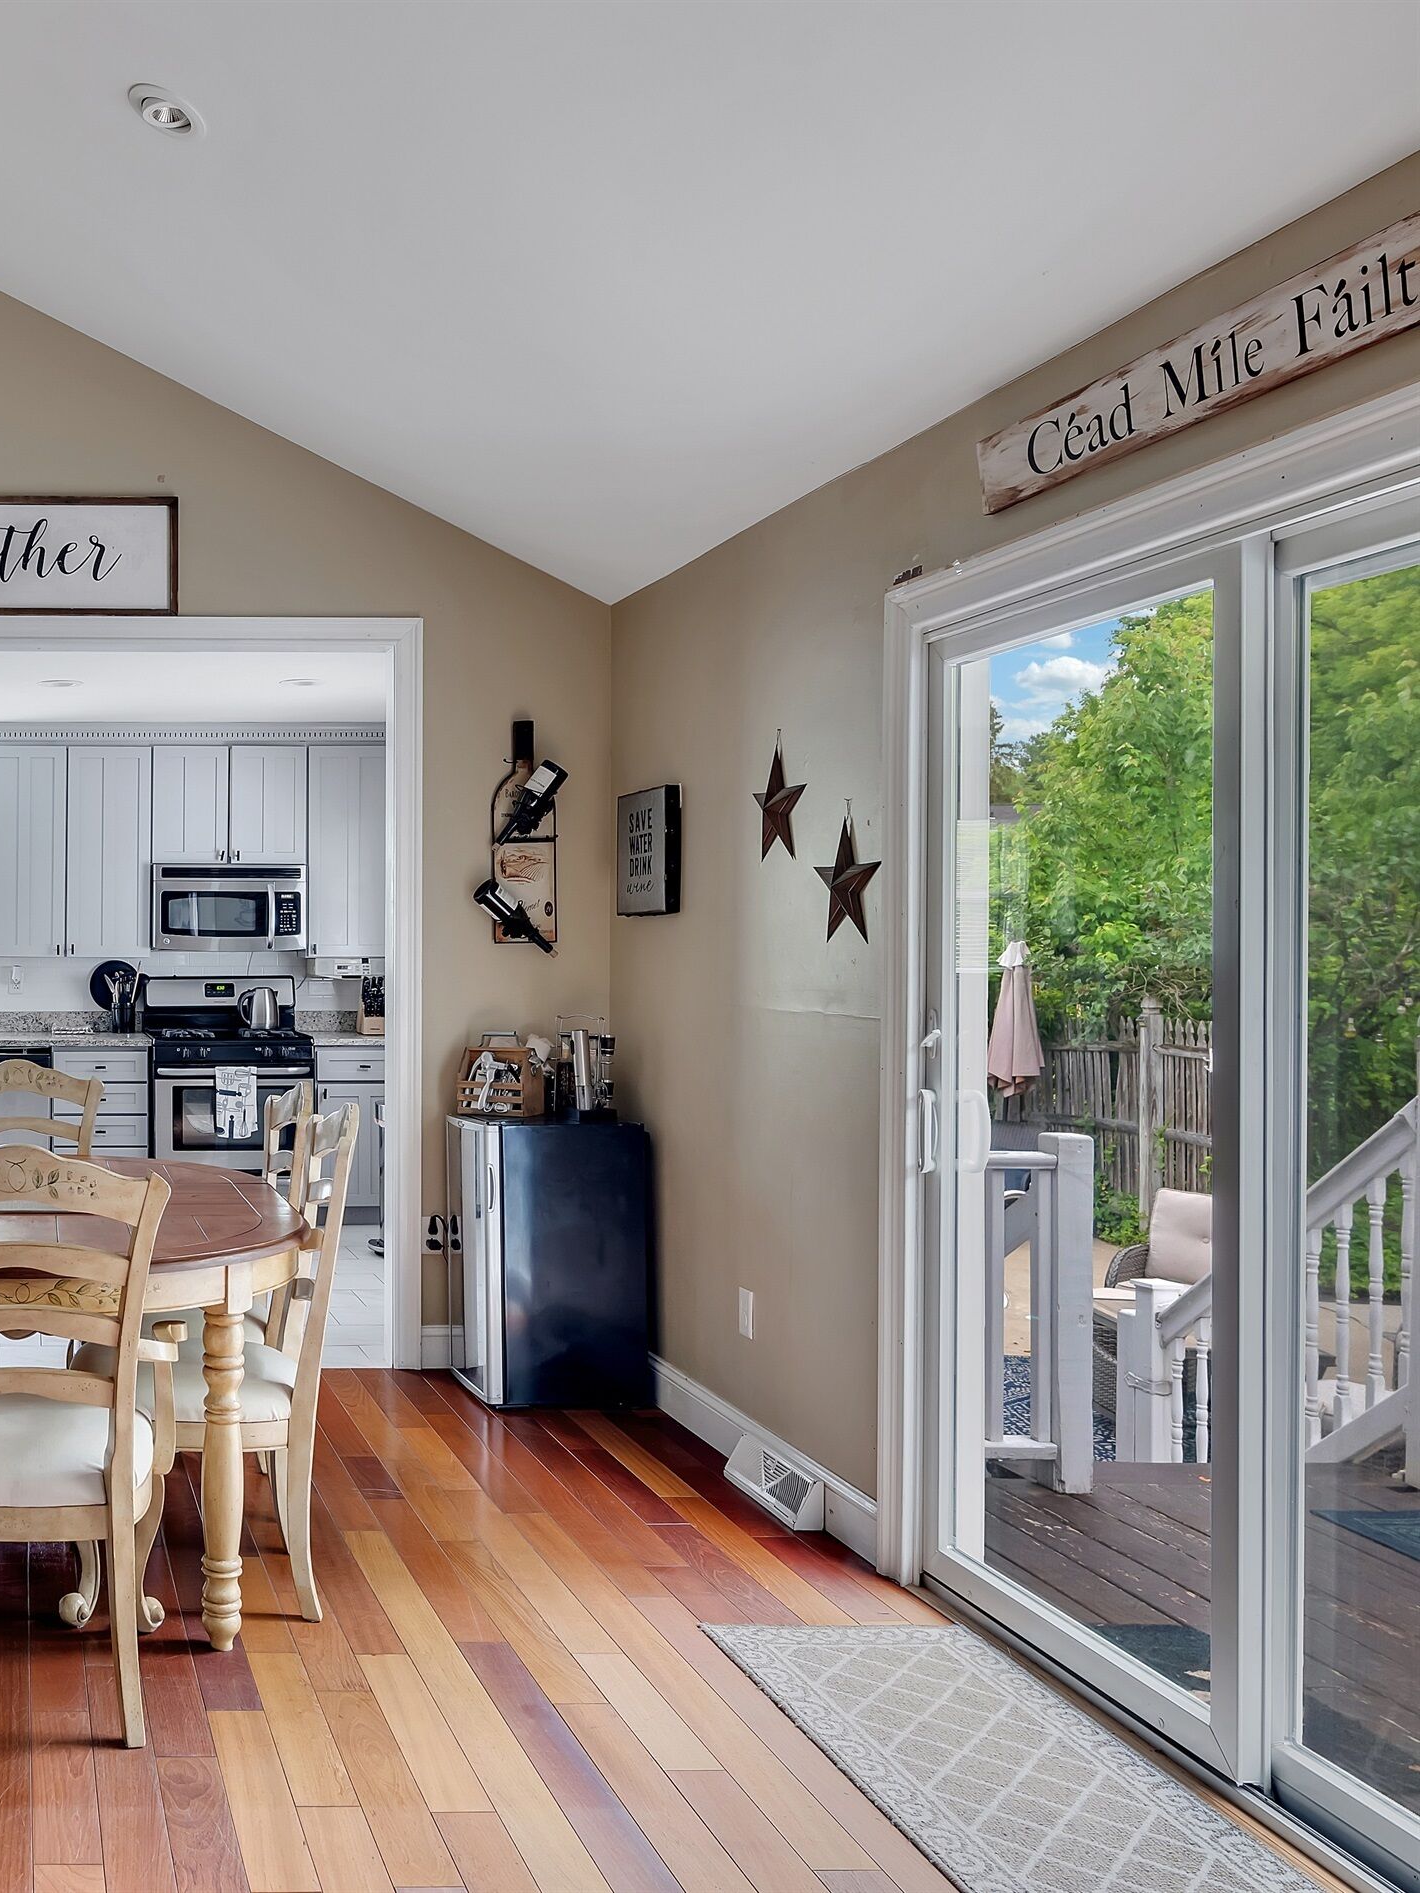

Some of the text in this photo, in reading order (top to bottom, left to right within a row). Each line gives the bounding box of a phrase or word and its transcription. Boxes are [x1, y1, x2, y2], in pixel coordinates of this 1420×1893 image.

[1026, 252, 1420, 475] Céad Míle Fáilt
[628, 807, 653, 834] SAVE
[628, 832, 653, 856] WATER
[629, 854, 653, 879] DRINK
[626, 879, 654, 895] wine
